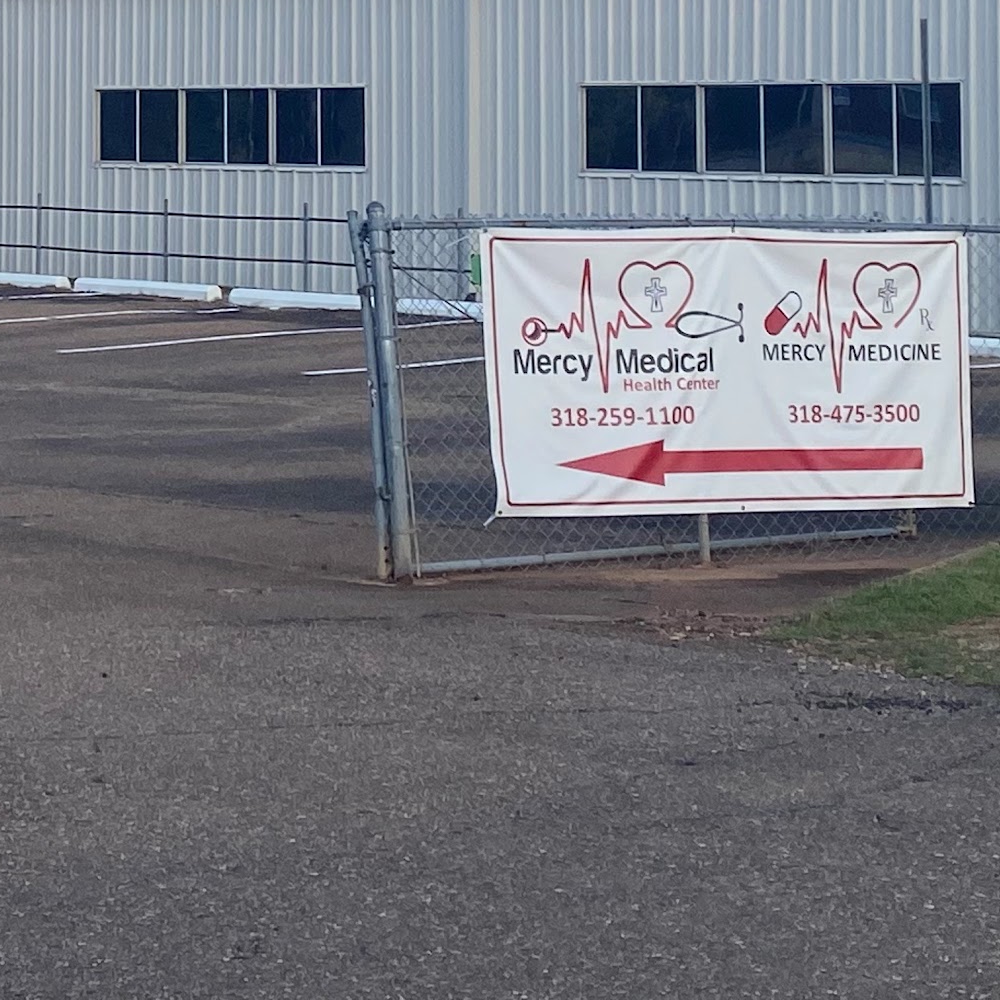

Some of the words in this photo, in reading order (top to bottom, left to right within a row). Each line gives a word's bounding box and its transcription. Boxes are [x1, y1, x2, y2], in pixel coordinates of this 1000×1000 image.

[762, 343, 826, 361] MERCY
[848, 343, 942, 361] MEDICINE
[513, 347, 593, 381] Mercy
[616, 347, 714, 374] Medical
[623, 377, 672, 392] Health
[677, 377, 720, 391] Center
[551, 405, 695, 427] 318-259-1100
[788, 404, 920, 423] 318-475-3500
